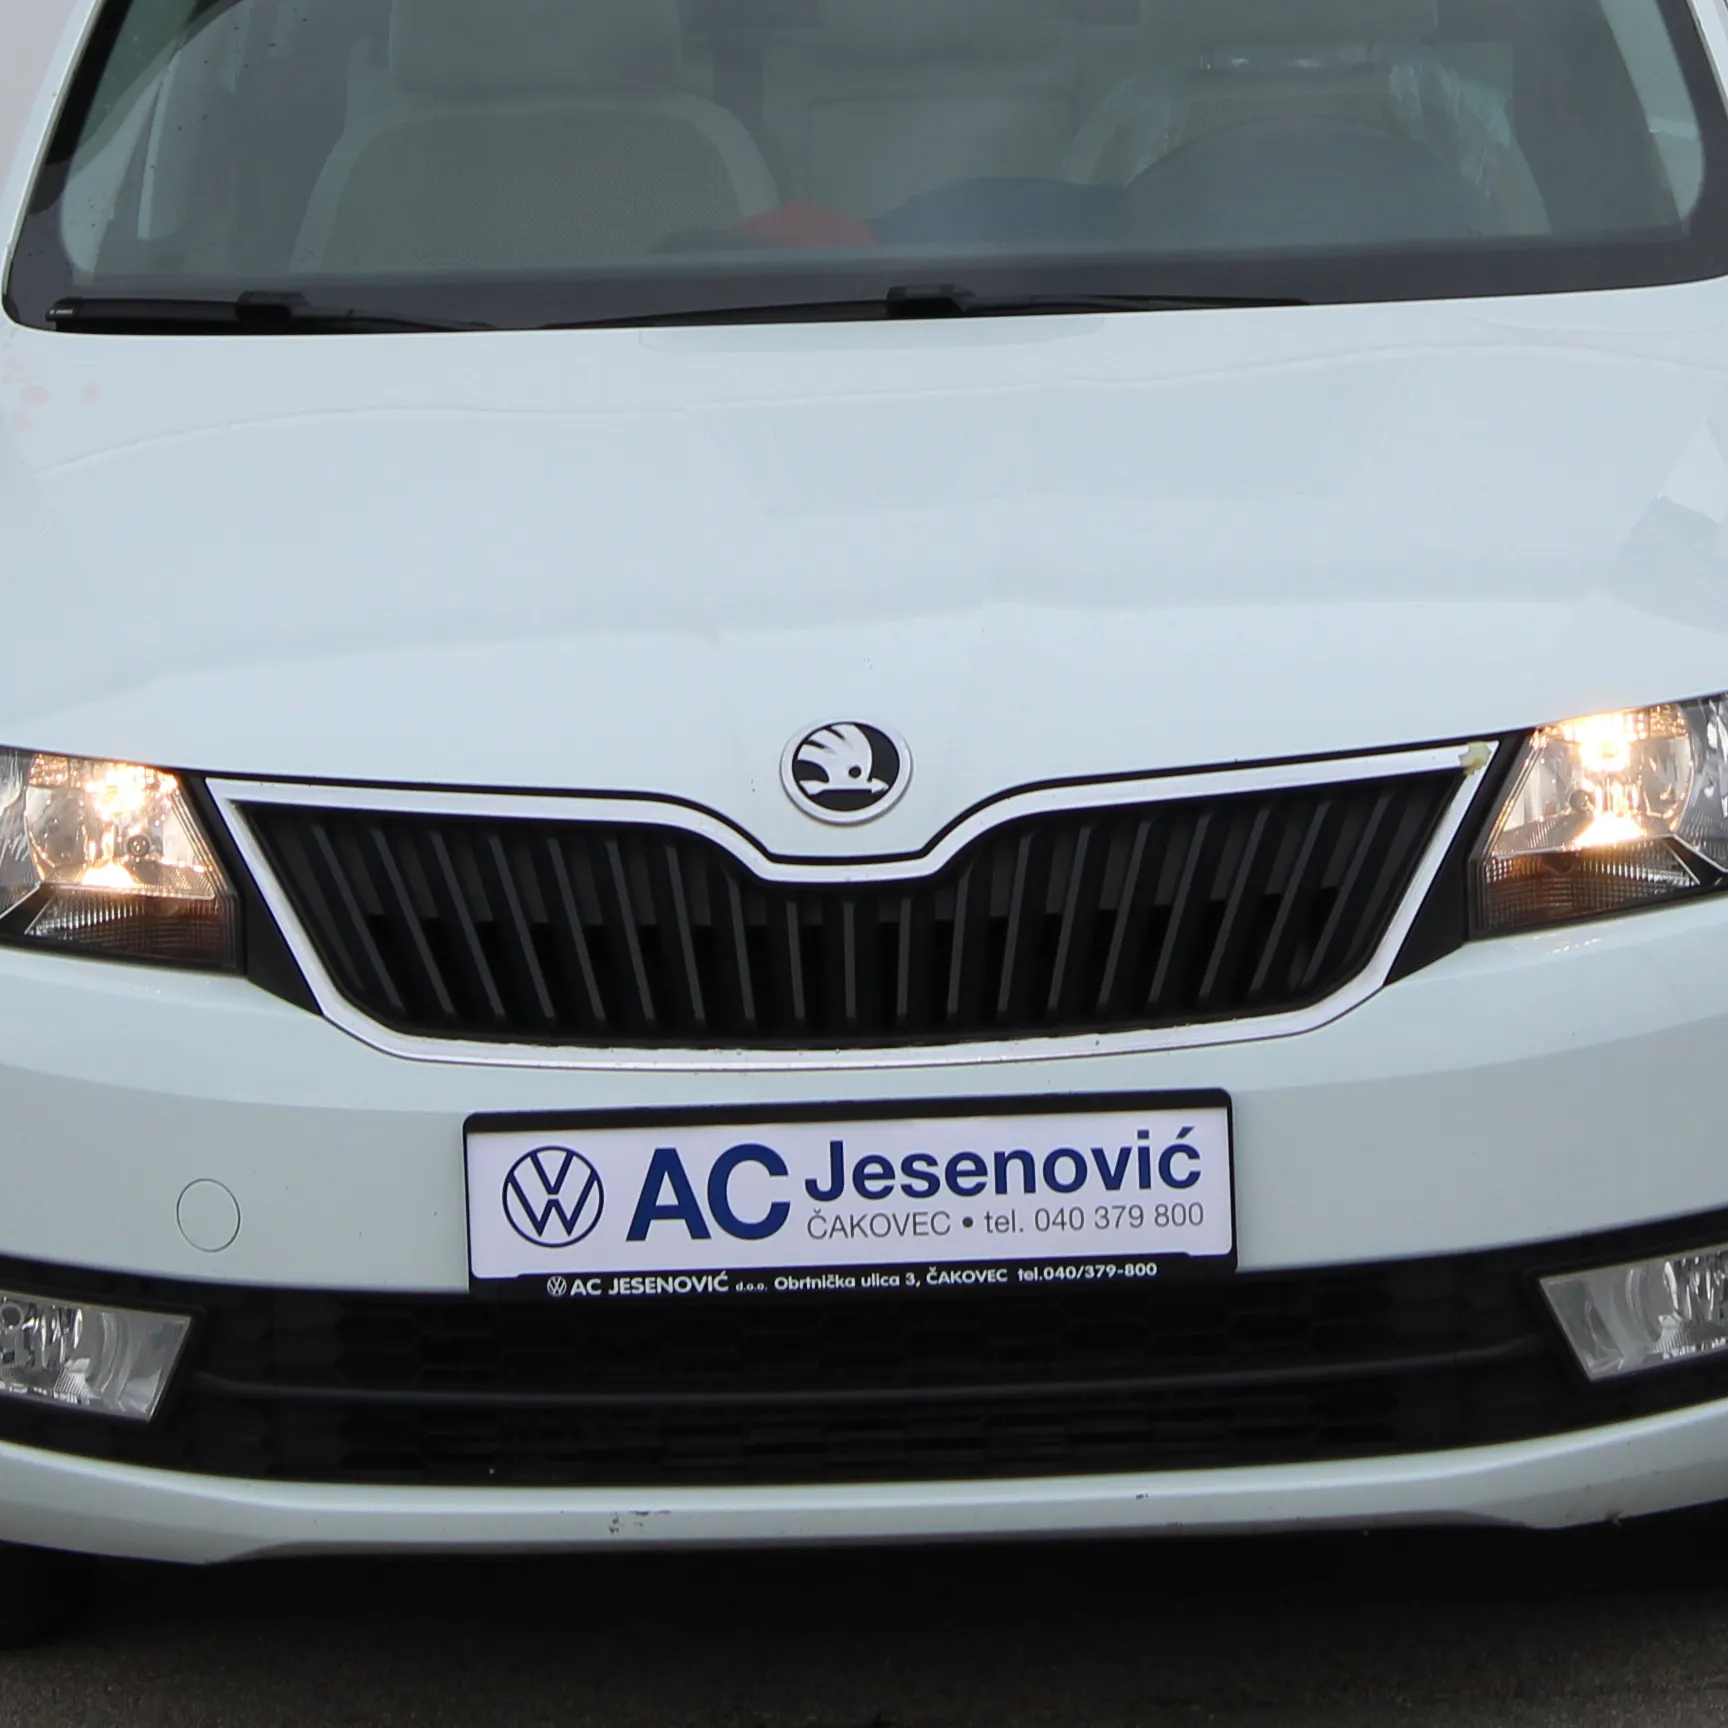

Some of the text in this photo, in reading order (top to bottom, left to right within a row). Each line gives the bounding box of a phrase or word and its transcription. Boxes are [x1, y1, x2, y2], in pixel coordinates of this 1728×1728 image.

[625, 1126, 1202, 1242] AC Jesenović
[806, 1202, 1204, 1240] ČAKOVEC tel. 040 379 800
[570, 1277, 602, 1296] AC
[607, 1270, 729, 1294] JESENOVIĆ
[774, 1273, 856, 1291] Obrtnička
[860, 1272, 900, 1288] ulica
[926, 1266, 1008, 1285] ČAKOVEC
